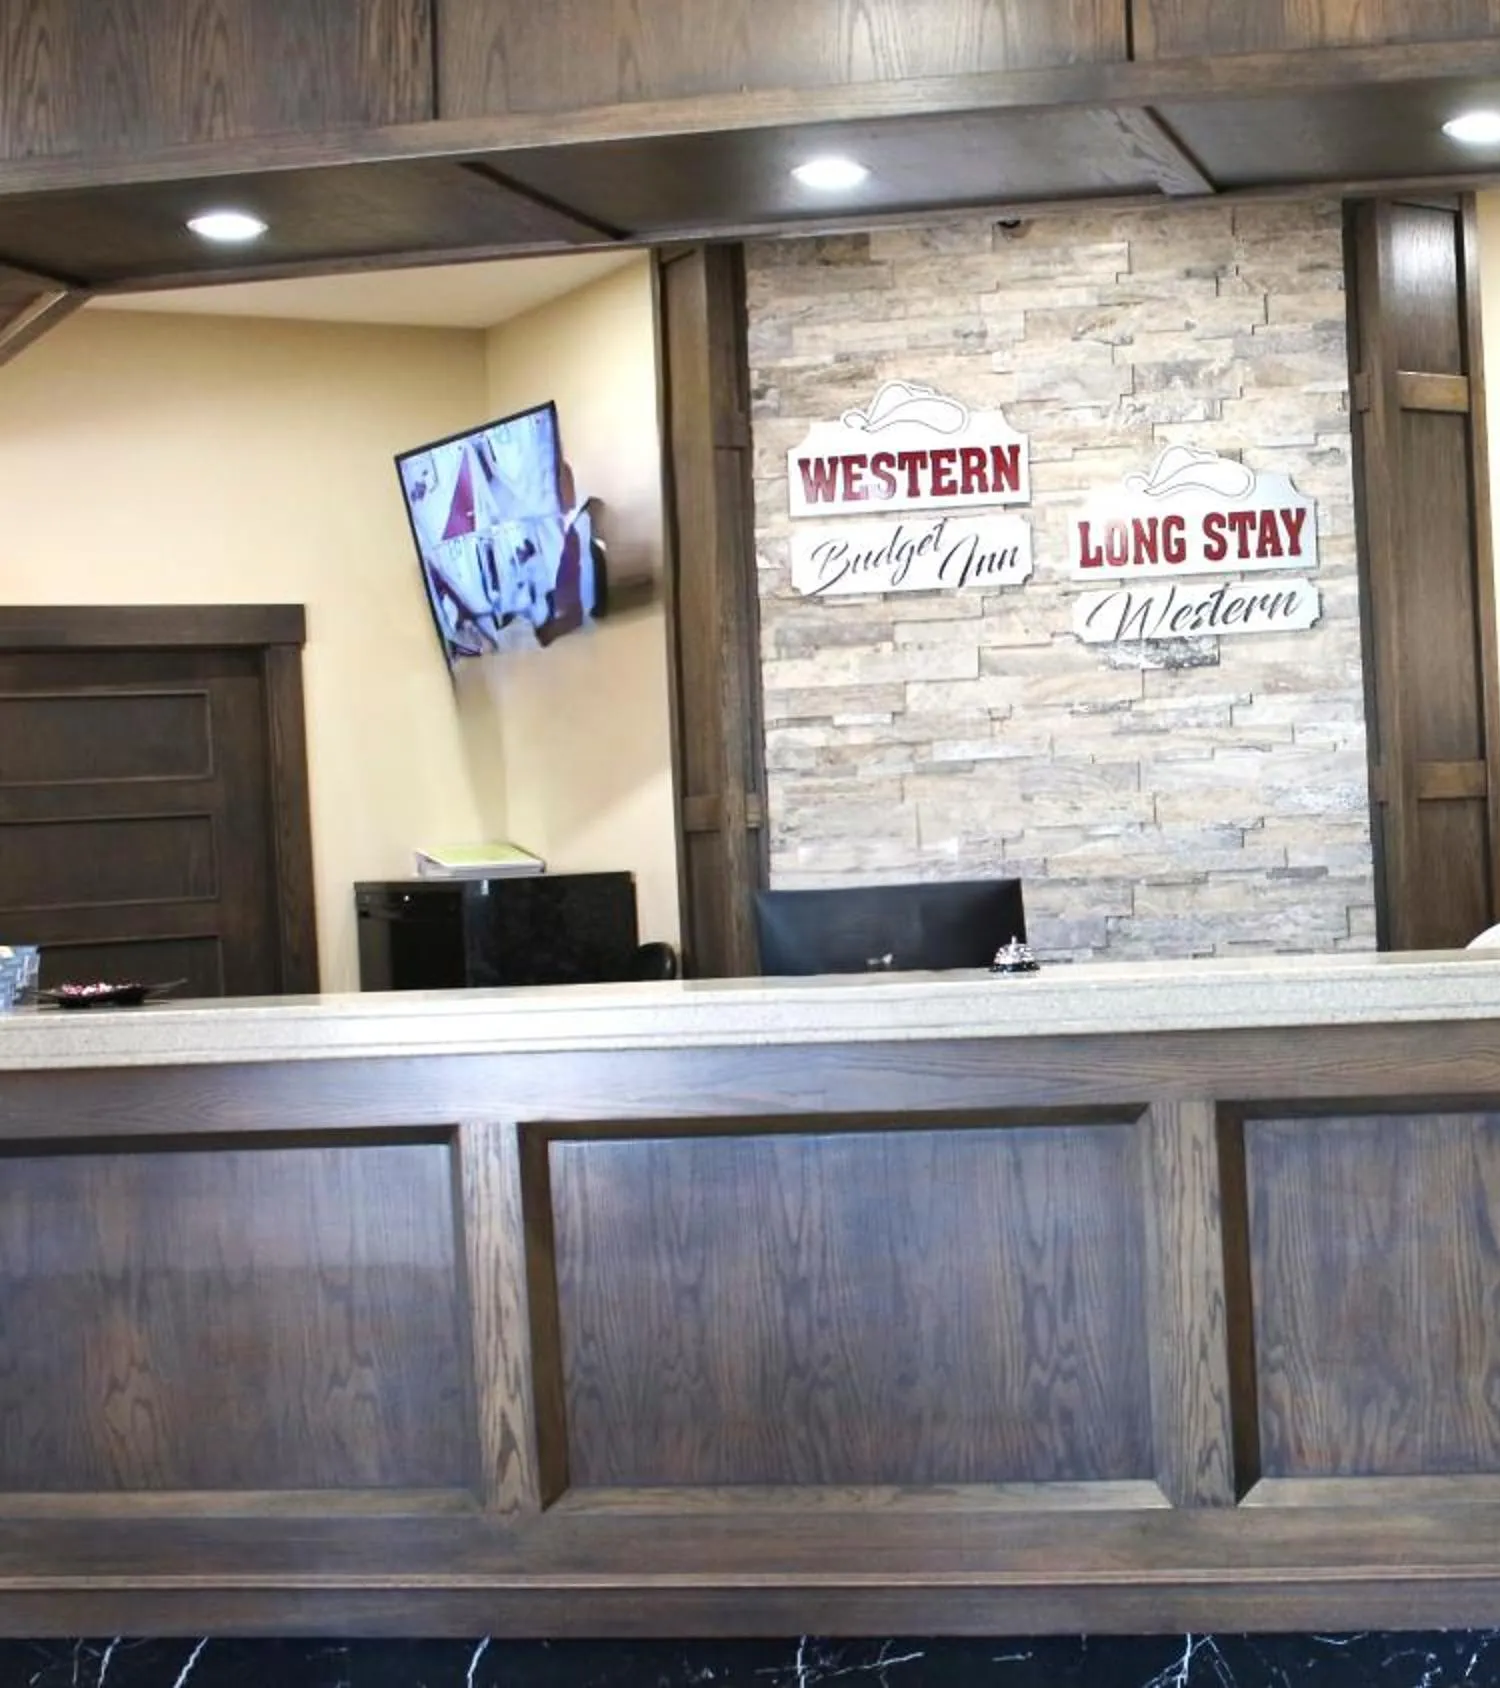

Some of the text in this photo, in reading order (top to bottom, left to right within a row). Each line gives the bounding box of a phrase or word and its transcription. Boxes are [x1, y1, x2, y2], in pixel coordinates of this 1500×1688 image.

[798, 444, 1020, 504] WESTERN
[808, 518, 1019, 596] Budget Inn
[1077, 507, 1307, 568] LONG STAY
[1085, 583, 1303, 643] Western
